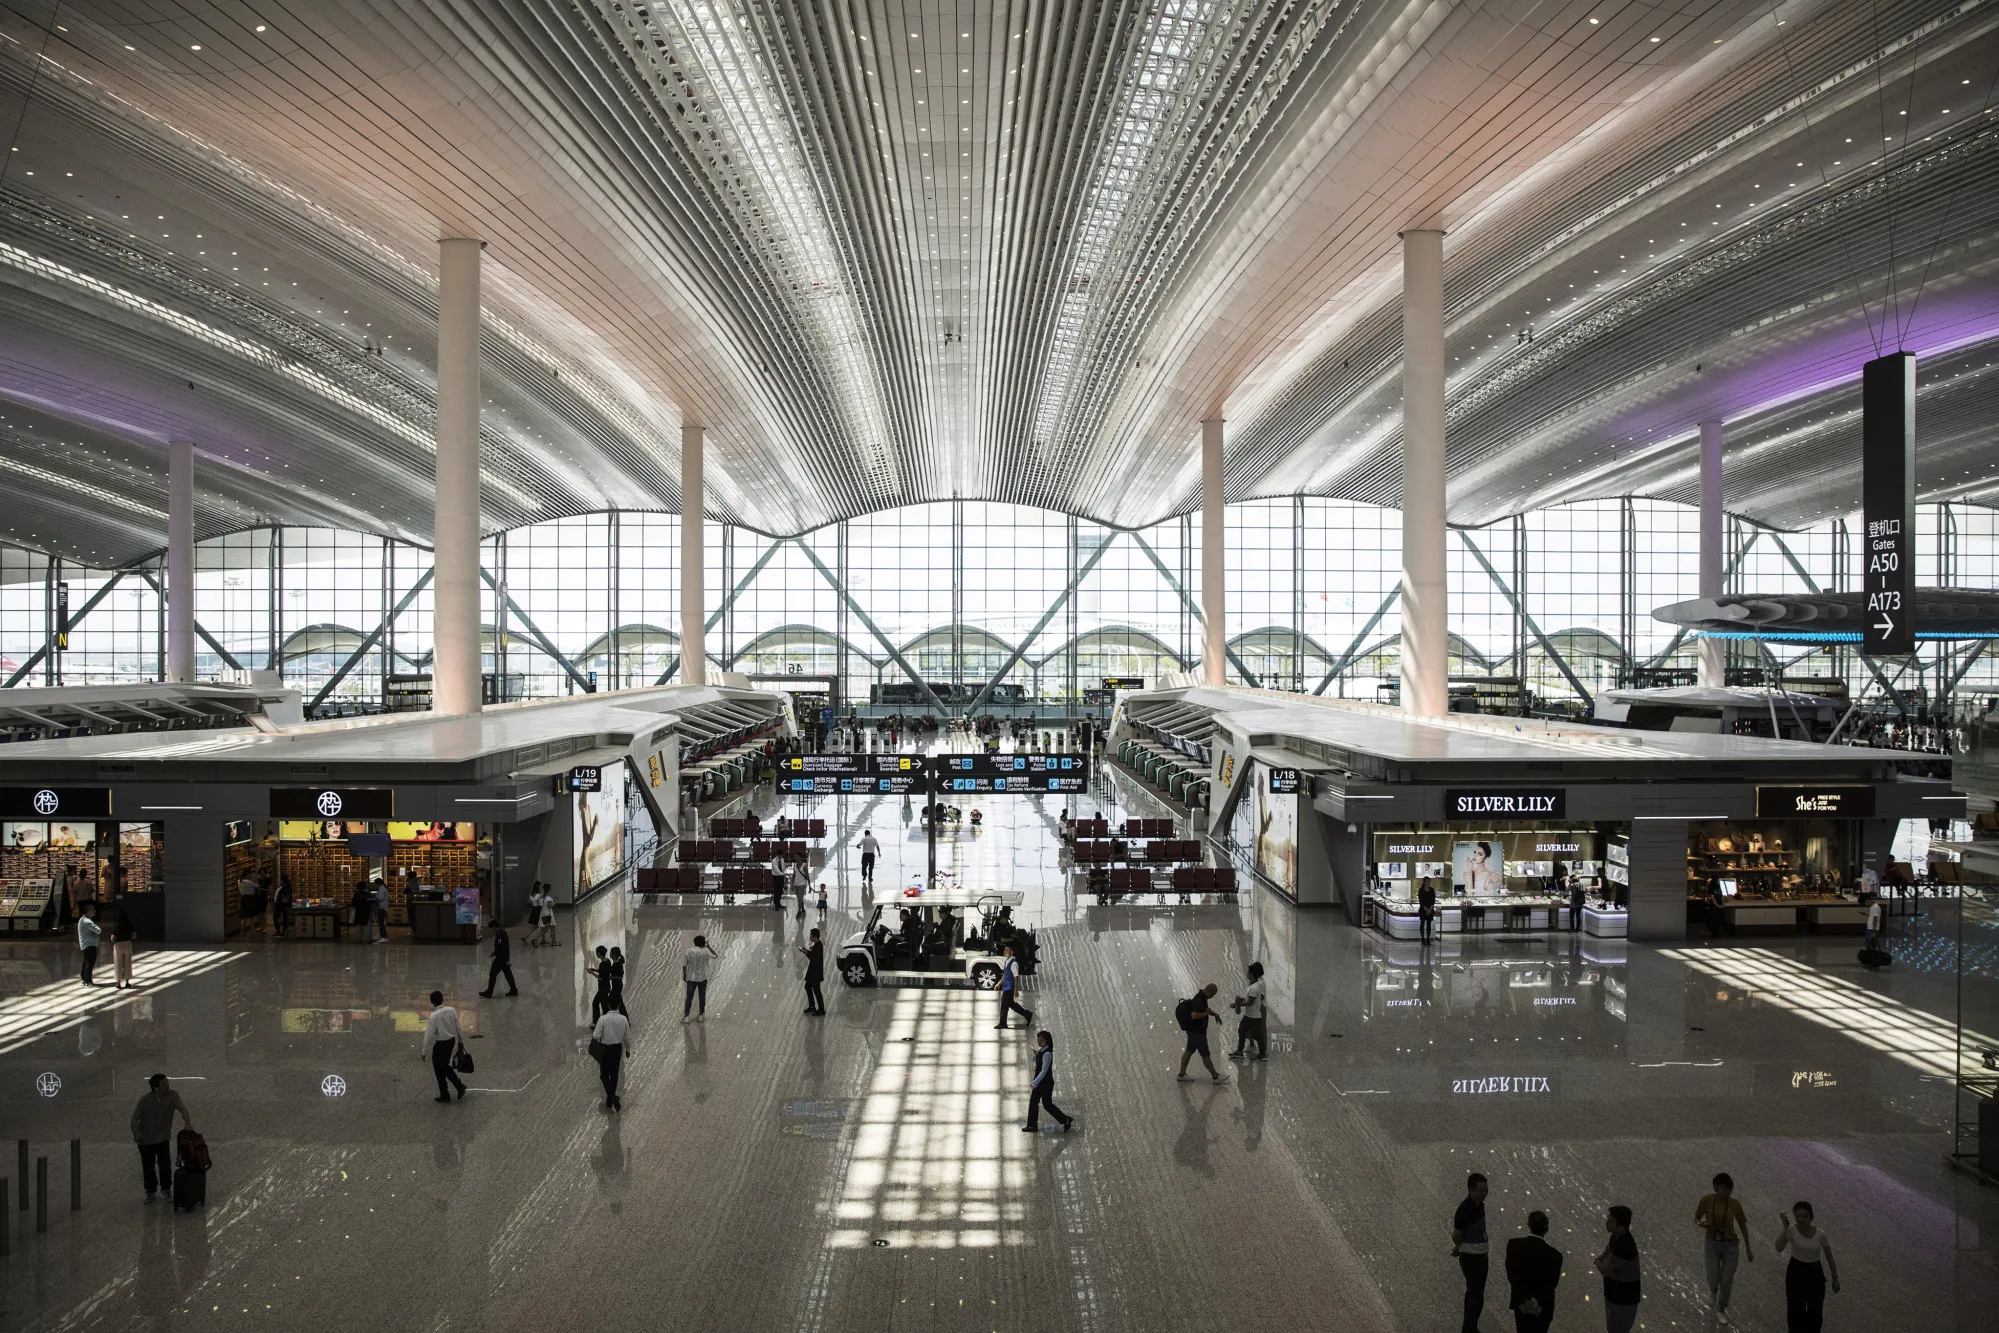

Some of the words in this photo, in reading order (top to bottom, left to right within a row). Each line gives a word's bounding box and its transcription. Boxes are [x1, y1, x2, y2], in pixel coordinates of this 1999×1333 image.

[1868, 519, 1900, 538] 登机口
[1872, 539, 1895, 551] Gates
[1870, 552, 1898, 573] A50
[1868, 591, 1901, 611] A173
[59, 632, 67, 647] N
[575, 769, 596, 778] L/19
[1274, 771, 1295, 779] L/18
[1457, 796, 1515, 812] SILVER
[1517, 796, 1556, 812] LILY
[1795, 795, 1817, 811] She's
[1389, 845, 1415, 853] SILVER
[1416, 845, 1434, 853] LILY
[1535, 843, 1561, 852] SILVER
[1562, 843, 1580, 852] LILY
